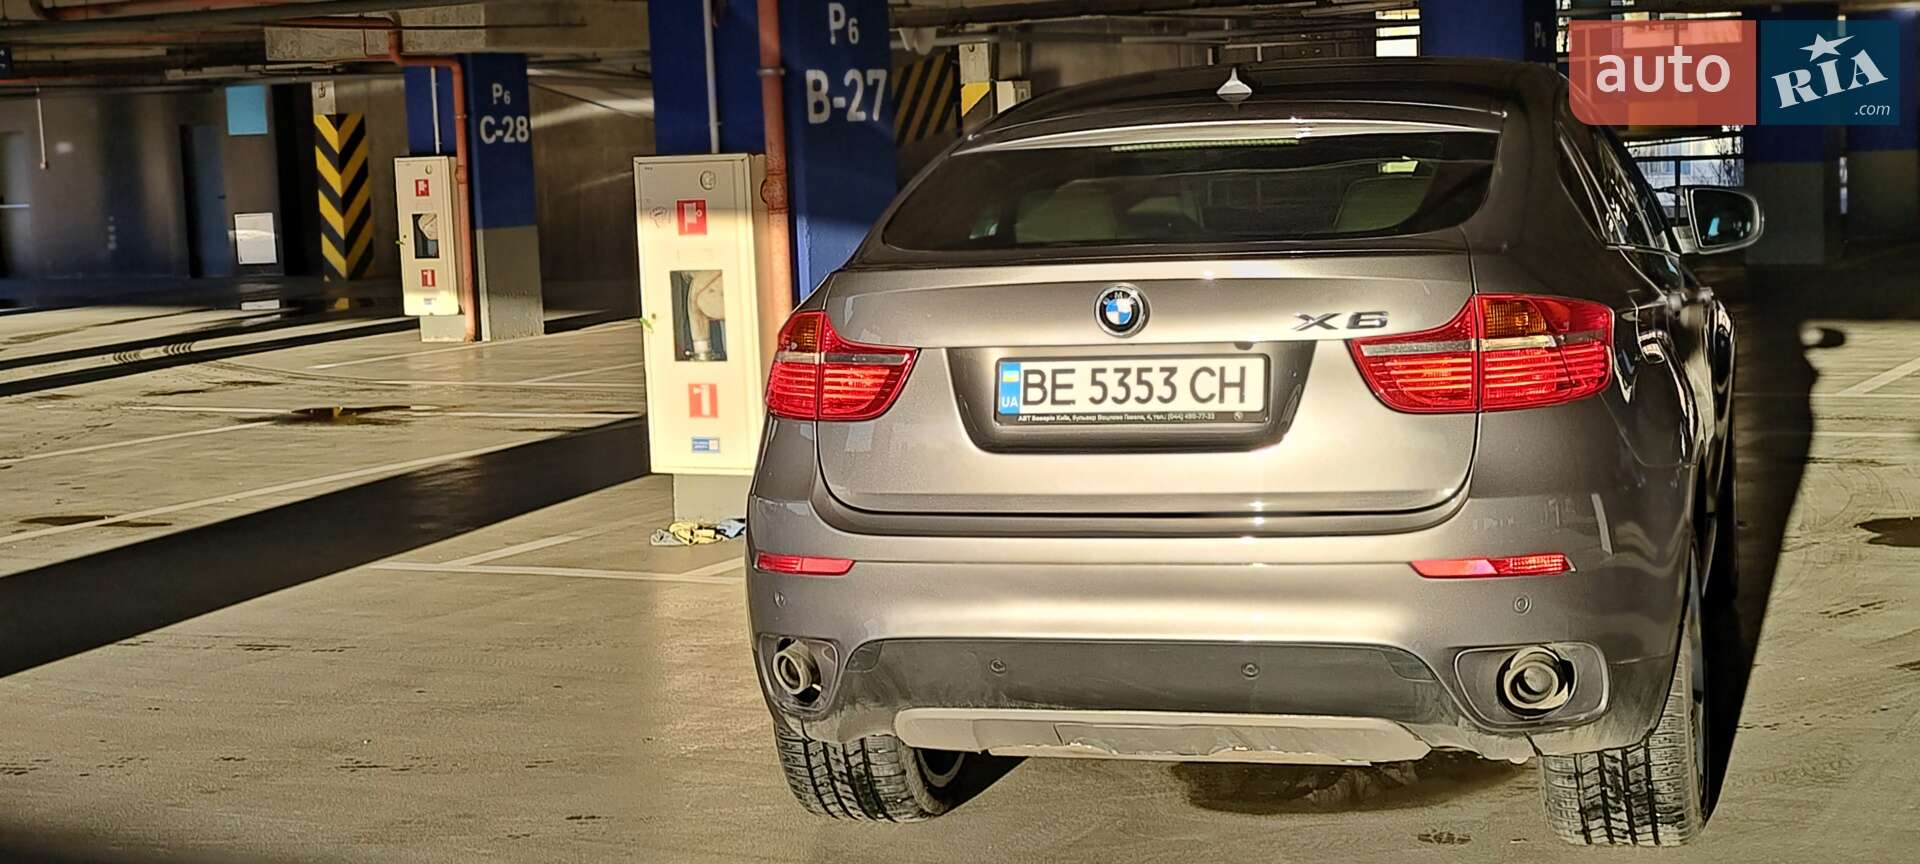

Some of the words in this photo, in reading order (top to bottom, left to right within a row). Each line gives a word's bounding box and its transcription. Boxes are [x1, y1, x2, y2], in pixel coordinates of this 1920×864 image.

[805, 68, 888, 124] B-27
[479, 115, 530, 145] C-28
[1292, 311, 1389, 332] X6
[1022, 368, 1077, 406] BE
[1088, 366, 1179, 406] 5353
[1189, 365, 1247, 405] CH
[1001, 396, 1019, 408] UA
